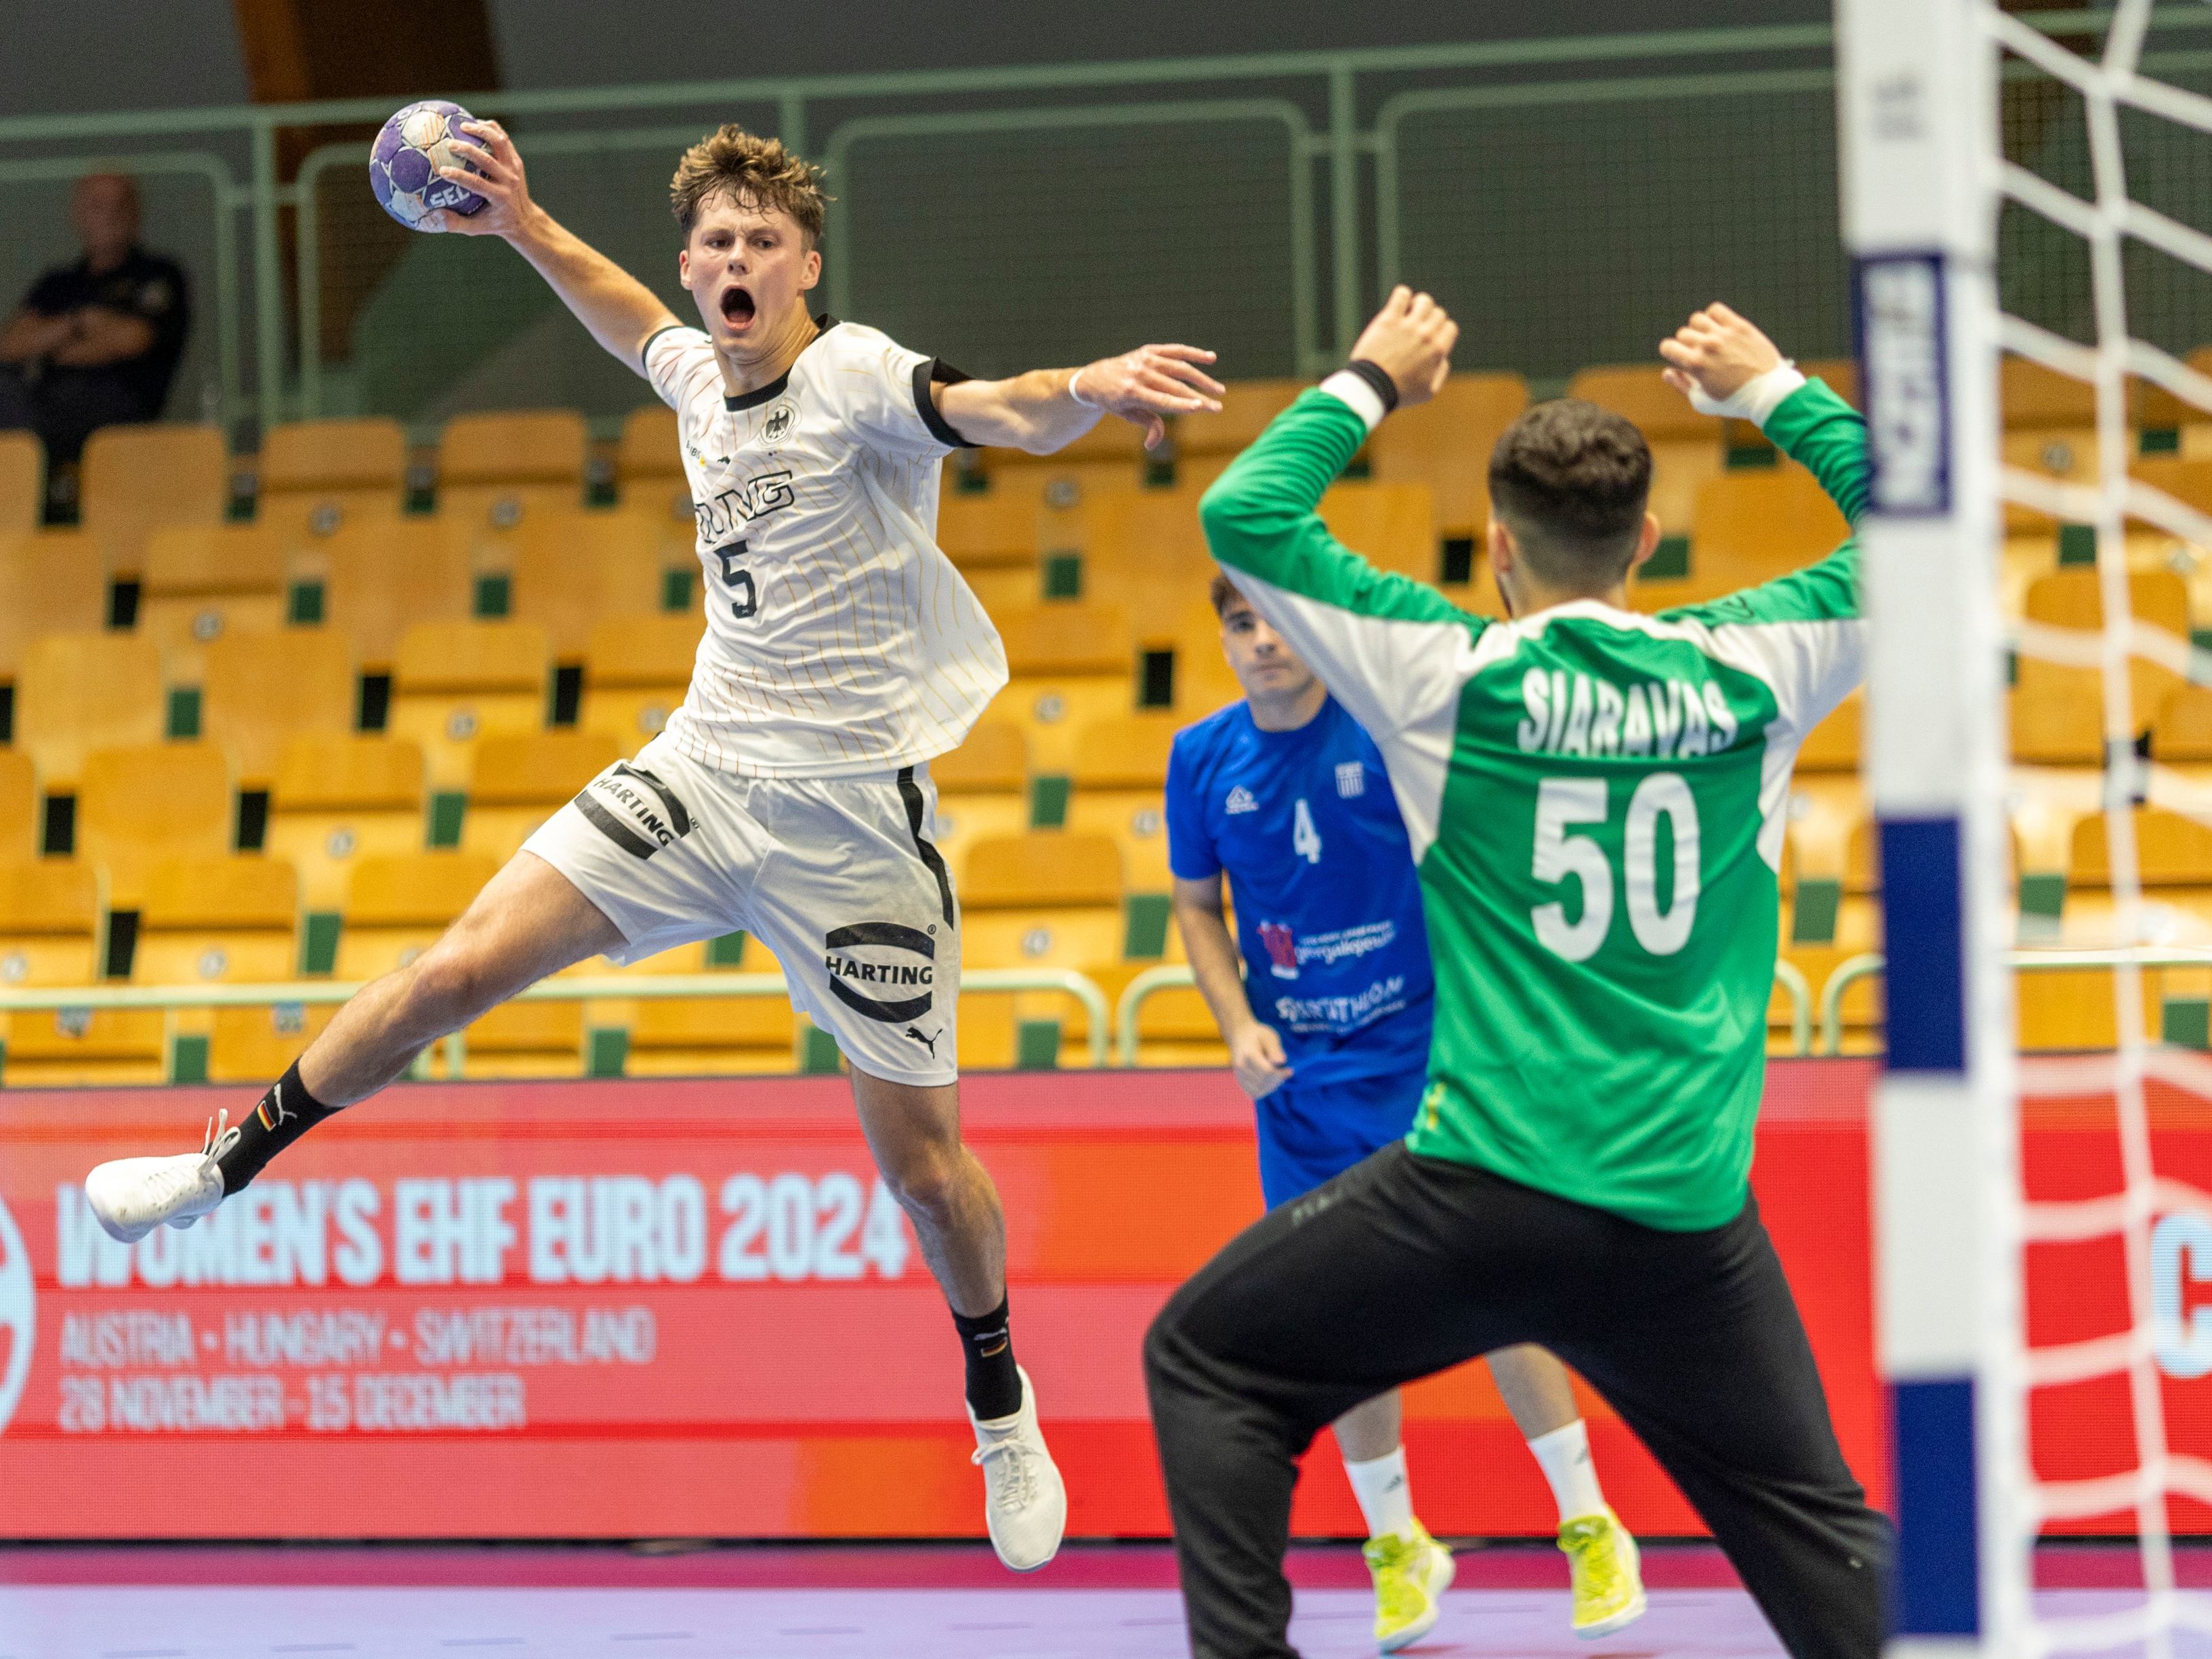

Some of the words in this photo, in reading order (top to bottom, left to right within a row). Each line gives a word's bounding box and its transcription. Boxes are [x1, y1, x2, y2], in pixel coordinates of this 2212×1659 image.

[714, 539, 757, 618] 5
[1518, 667, 1738, 759] SIARAVAS
[593, 778, 675, 847] HARTING
[1293, 799, 1322, 864] 4
[1530, 772, 1701, 963] 50
[825, 956, 932, 984] HARTING
[394, 1177, 516, 1284] EHF
[528, 1175, 705, 1283] EURO
[717, 1173, 908, 1281] 2024
[60, 1310, 197, 1368] AUSTRIA
[224, 1309, 387, 1367] HUNGARY
[414, 1307, 657, 1366] SWITZERLAND
[110, 1375, 284, 1431] NOVEMBER
[308, 1374, 350, 1430] 15
[355, 1372, 527, 1430] DECEMBER
